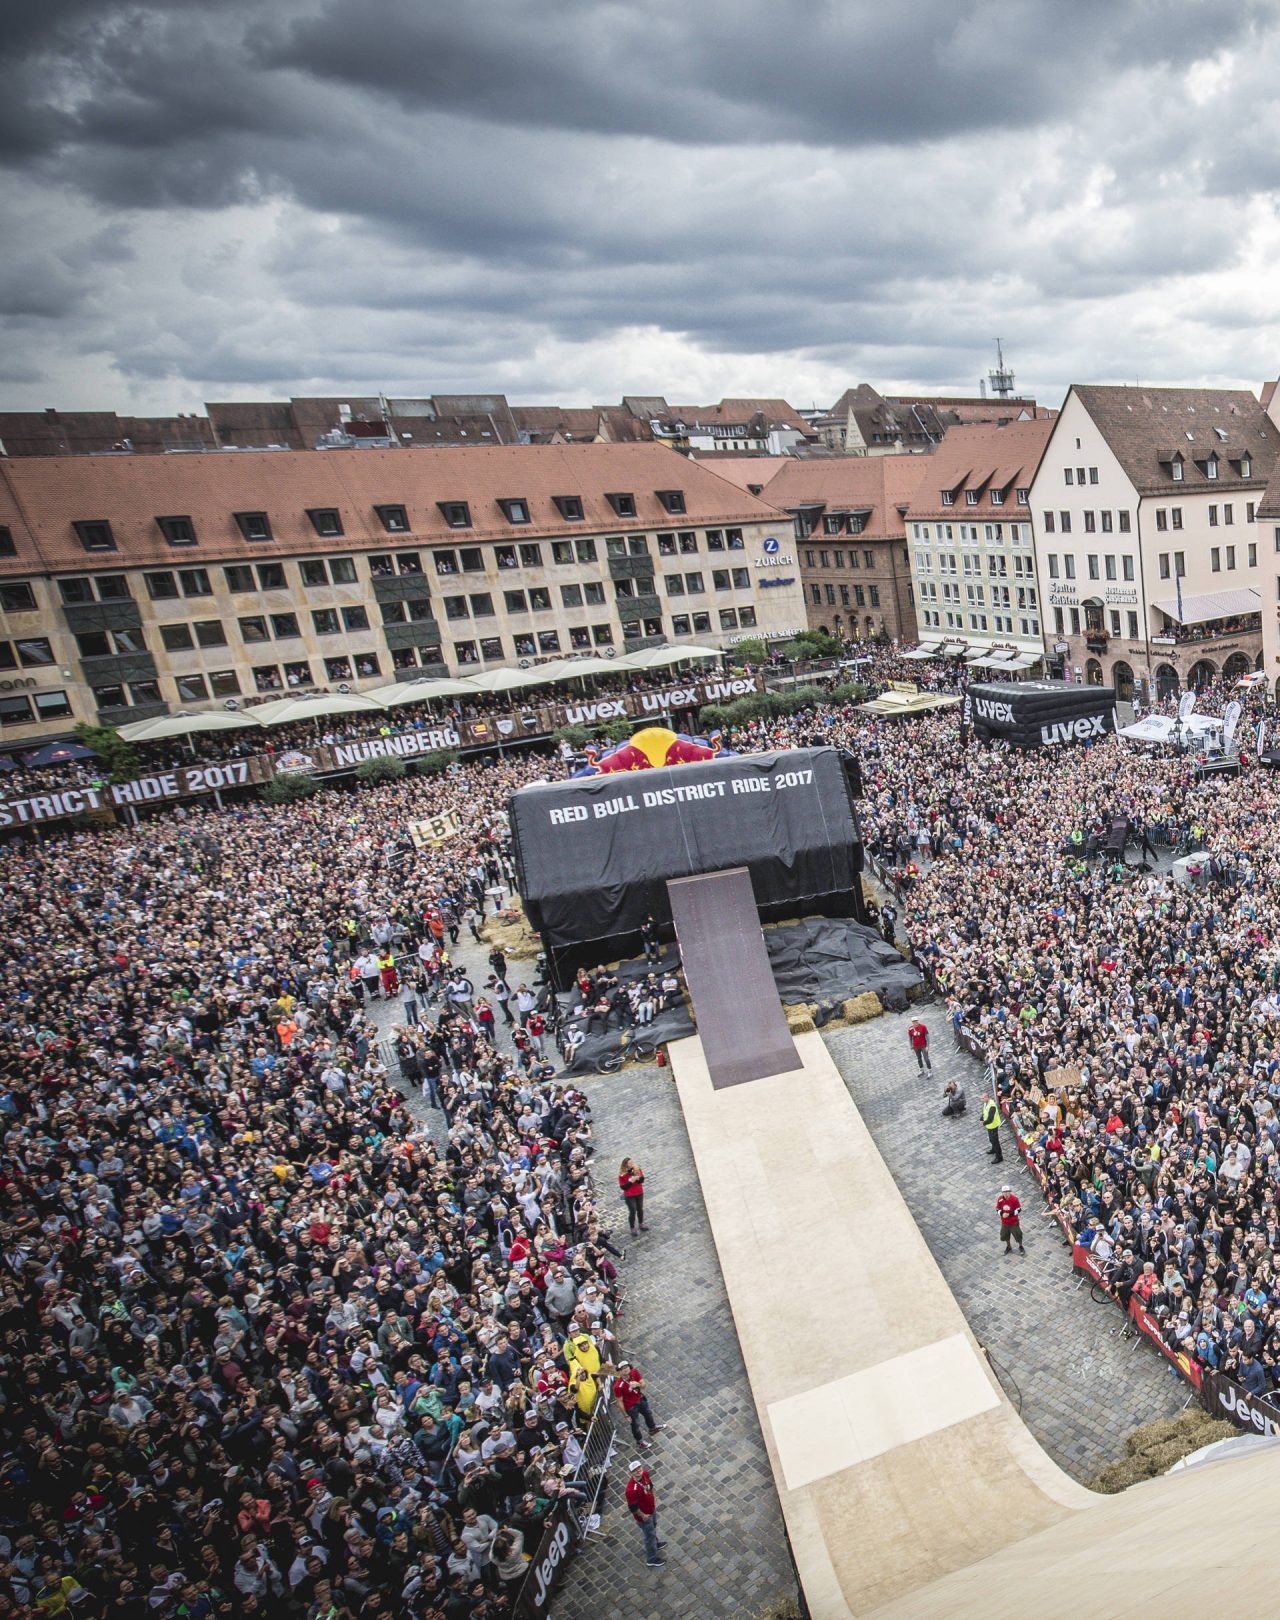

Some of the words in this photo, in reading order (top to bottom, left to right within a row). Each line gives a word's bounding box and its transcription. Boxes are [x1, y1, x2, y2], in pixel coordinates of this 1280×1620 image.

[754, 555, 793, 568] ZURICH
[642, 687, 698, 711] uvex
[704, 678, 757, 699] uvex
[566, 700, 628, 725] uvex
[975, 698, 1016, 723] uvex
[1041, 714, 1107, 745] uvex
[111, 774, 180, 804] RIDE
[186, 762, 248, 791] 2017
[549, 805, 589, 825] RED
[592, 797, 639, 819] BULL
[643, 781, 726, 808] DISTRICT
[731, 777, 771, 795] RIDE
[774, 769, 813, 790] 2017
[535, 1521, 569, 1607] Jeep
